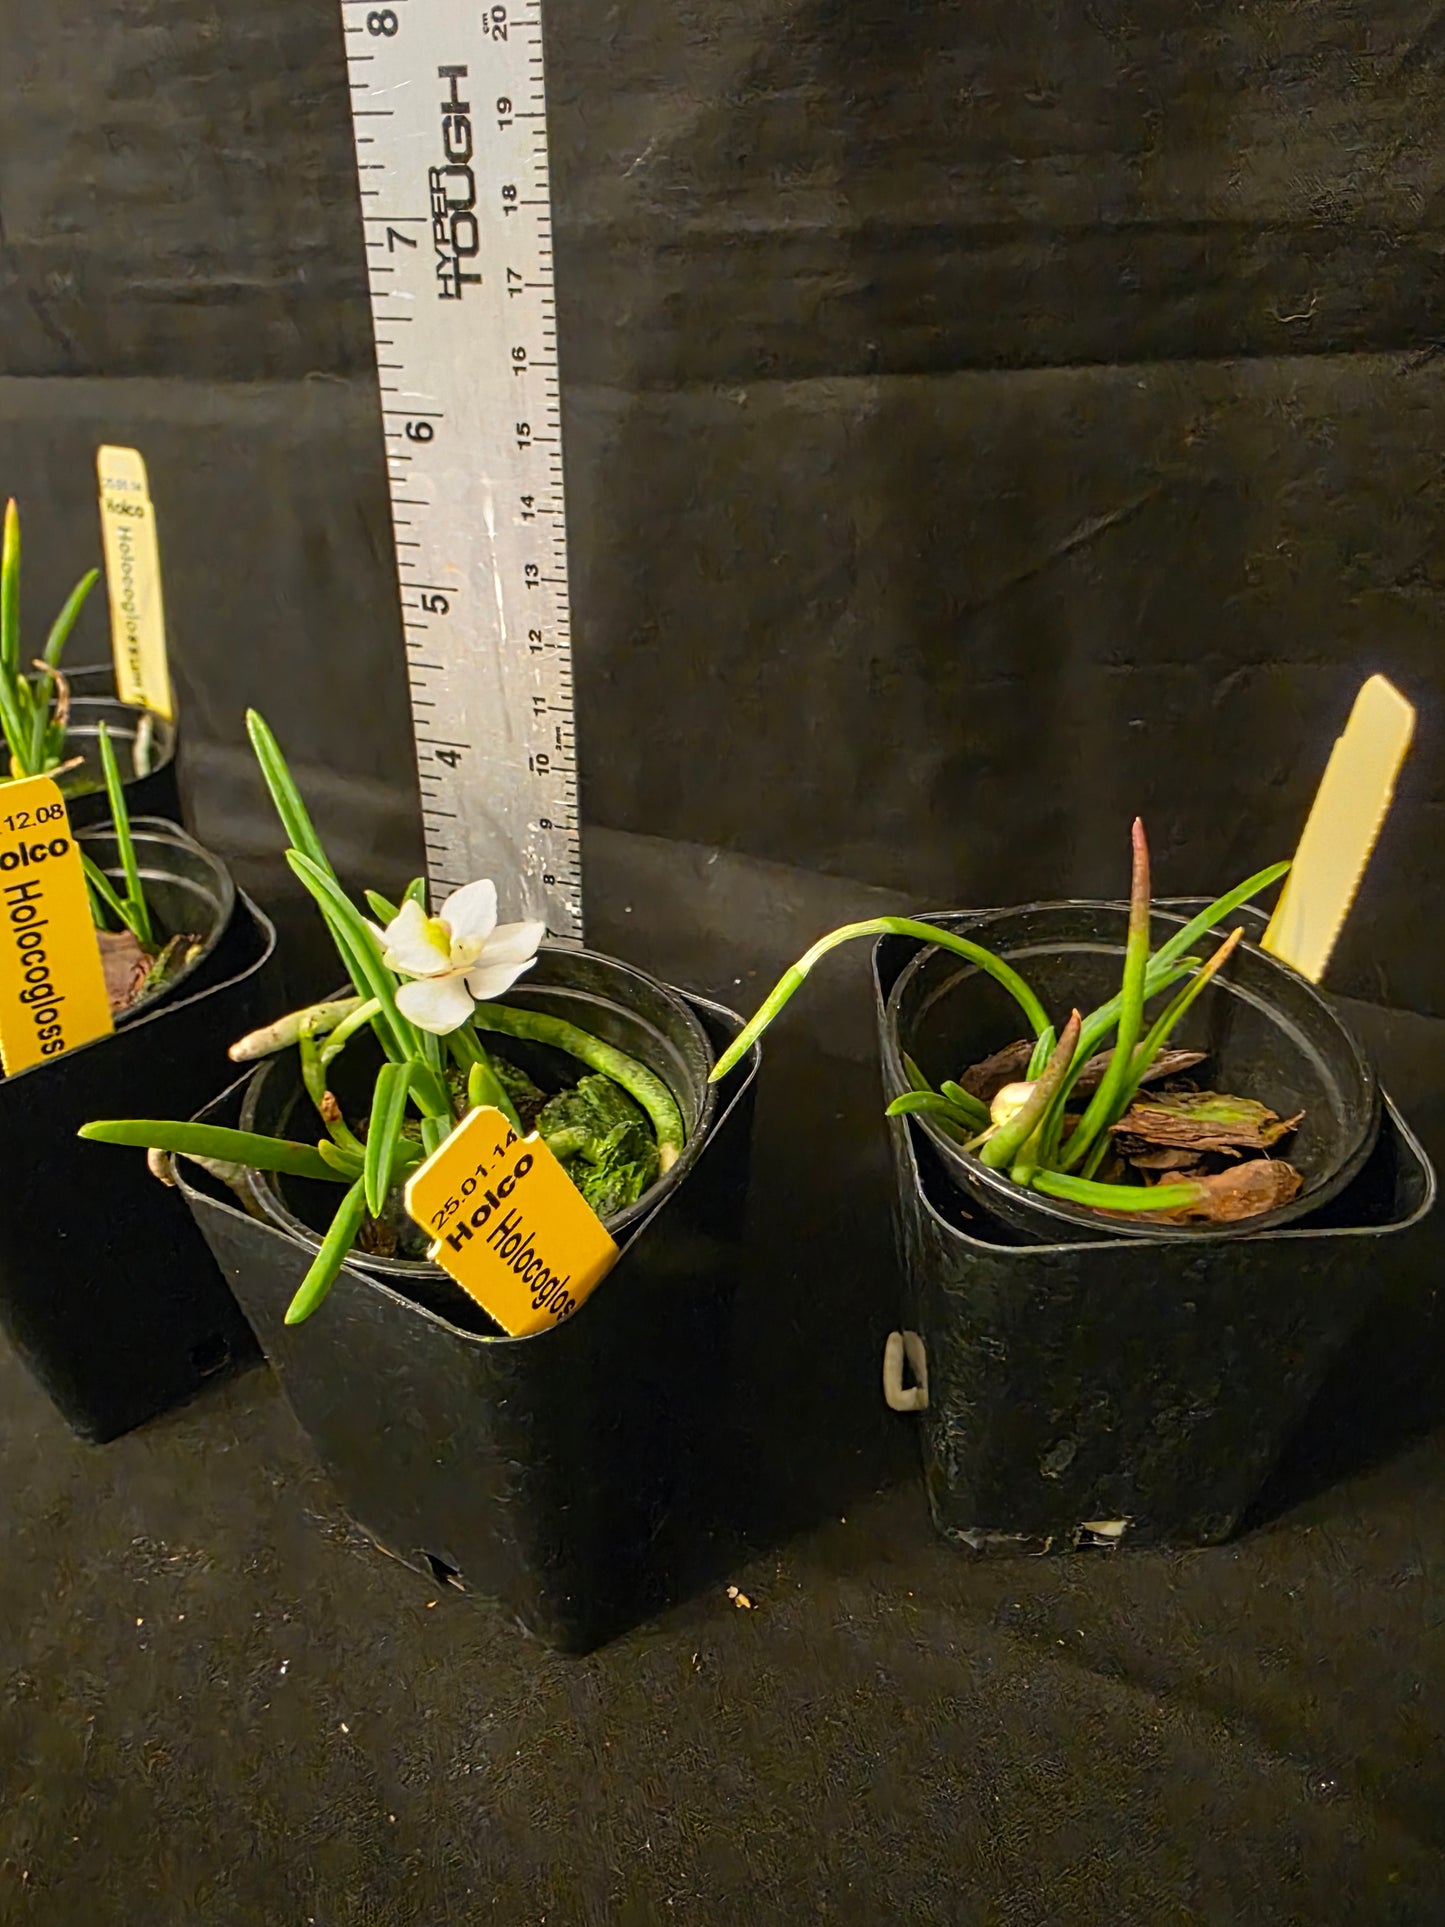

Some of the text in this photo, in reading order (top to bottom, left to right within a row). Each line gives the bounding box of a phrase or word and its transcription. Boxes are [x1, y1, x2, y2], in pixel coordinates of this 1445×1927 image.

[367, 9, 398, 37] 8
[482, 13, 490, 34] cm
[491, 5, 508, 42] 20
[497, 97, 513, 130] 19
[437, 65, 482, 300] TOUGH
[502, 184, 517, 216] 18
[387, 227, 417, 252] 7
[428, 166, 454, 300] HYPER
[507, 267, 522, 298] 17
[512, 346, 527, 376] 16
[405, 421, 434, 443] 6
[517, 422, 531, 450] 15
[521, 495, 535, 520] 14
[525, 564, 539, 589] 13
[422, 594, 450, 615] 5
[529, 629, 543, 654] 12
[532, 696, 547, 716] 11
[435, 750, 462, 769] 4
[536, 753, 549, 776] 10
[540, 818, 552, 830] 9
[543, 874, 555, 886] 8
[4, 879, 65, 1055] Holocogloss
[431, 1128, 518, 1231] 25.01.14
[445, 1154, 533, 1252] Holco
